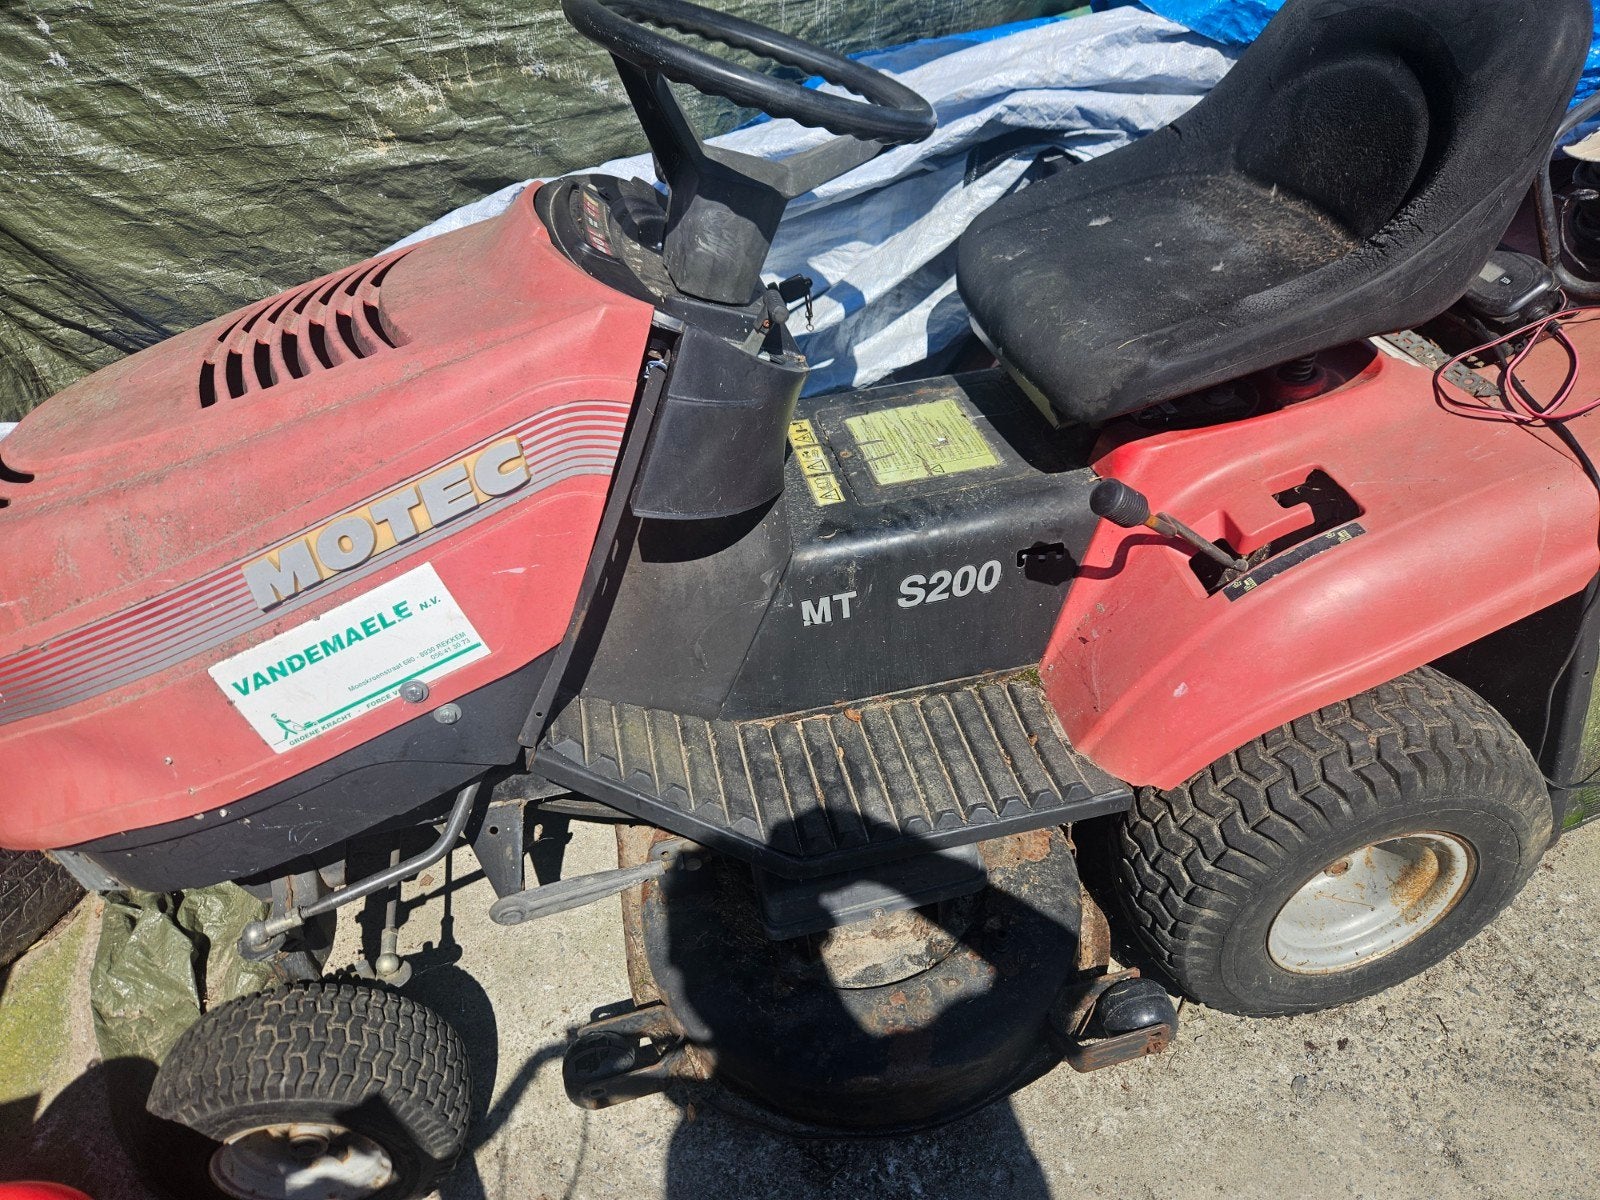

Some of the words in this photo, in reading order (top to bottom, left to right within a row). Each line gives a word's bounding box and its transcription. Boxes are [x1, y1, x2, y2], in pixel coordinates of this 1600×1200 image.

[241, 436, 531, 613] MOTEC
[801, 590, 857, 627] MT
[898, 560, 1002, 608] S200
[232, 600, 413, 697] VANDEMAELE
[419, 596, 441, 611] N.V.
[436, 631, 467, 650] REKKEM
[289, 728, 319, 746] GROENE
[321, 712, 352, 730] KRACHT
[366, 695, 392, 709] FORCE
